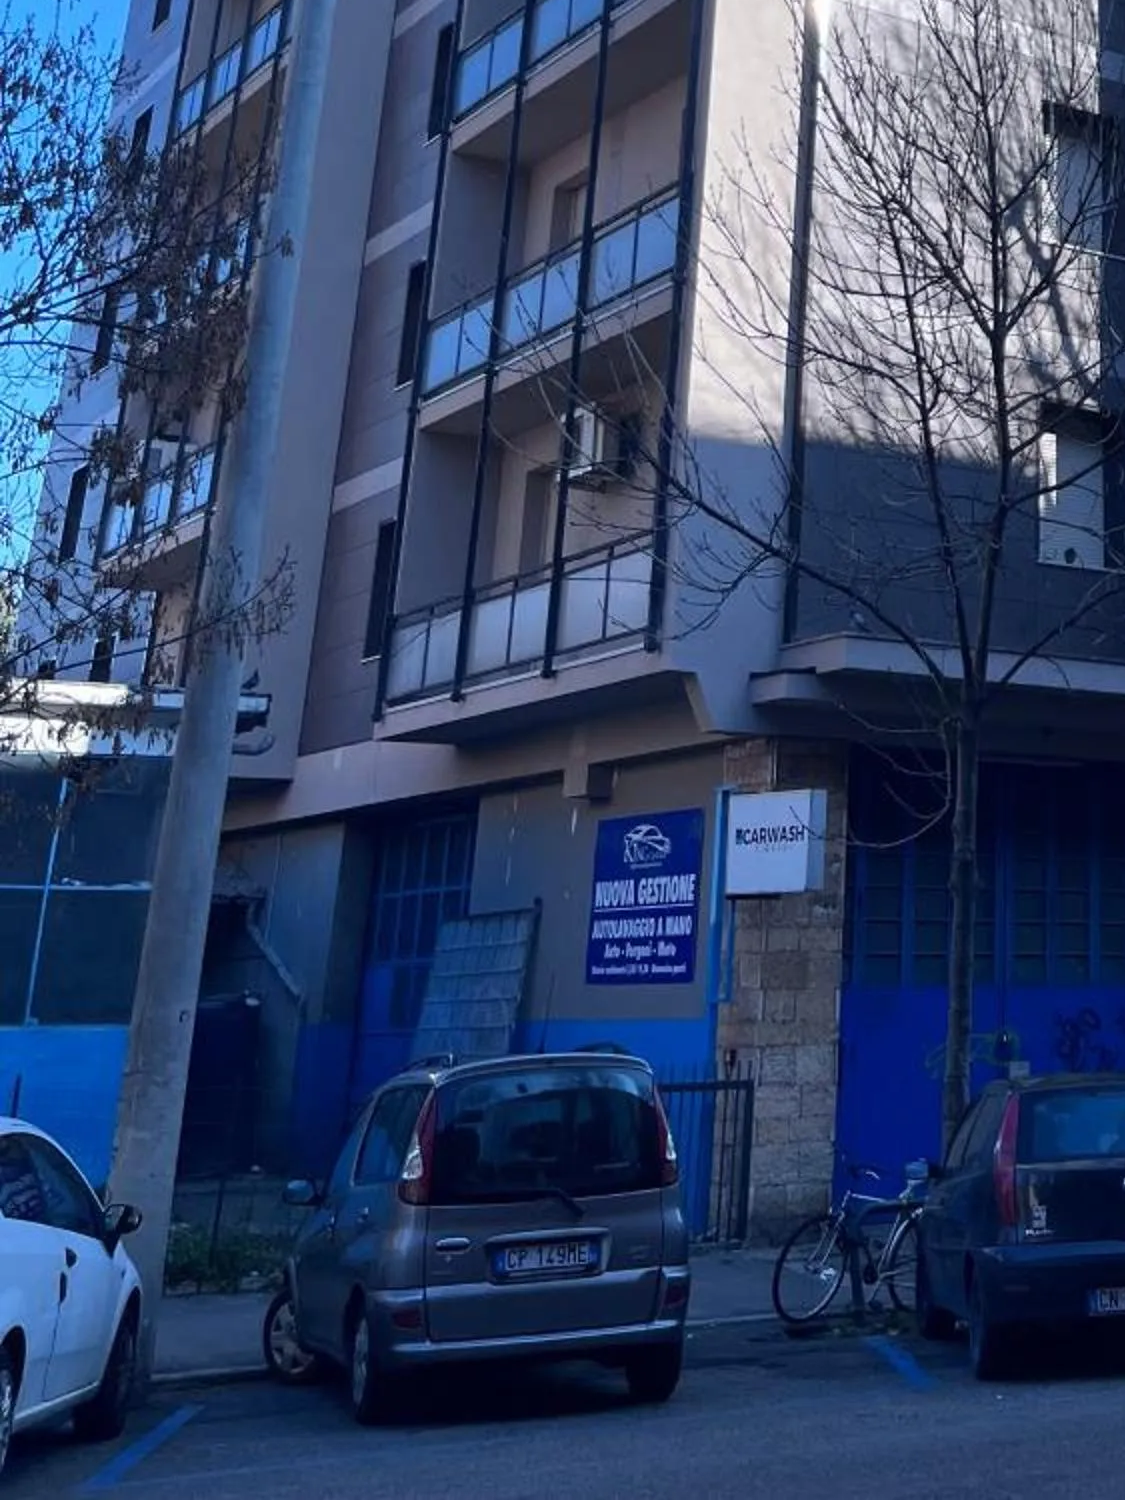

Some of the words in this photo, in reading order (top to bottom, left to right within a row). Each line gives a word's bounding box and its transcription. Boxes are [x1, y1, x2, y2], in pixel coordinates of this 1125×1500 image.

[595, 879, 635, 907] NUOVA
[638, 873, 697, 905] GESTIONE
[656, 916, 663, 937] A
[665, 915, 693, 936] MANO
